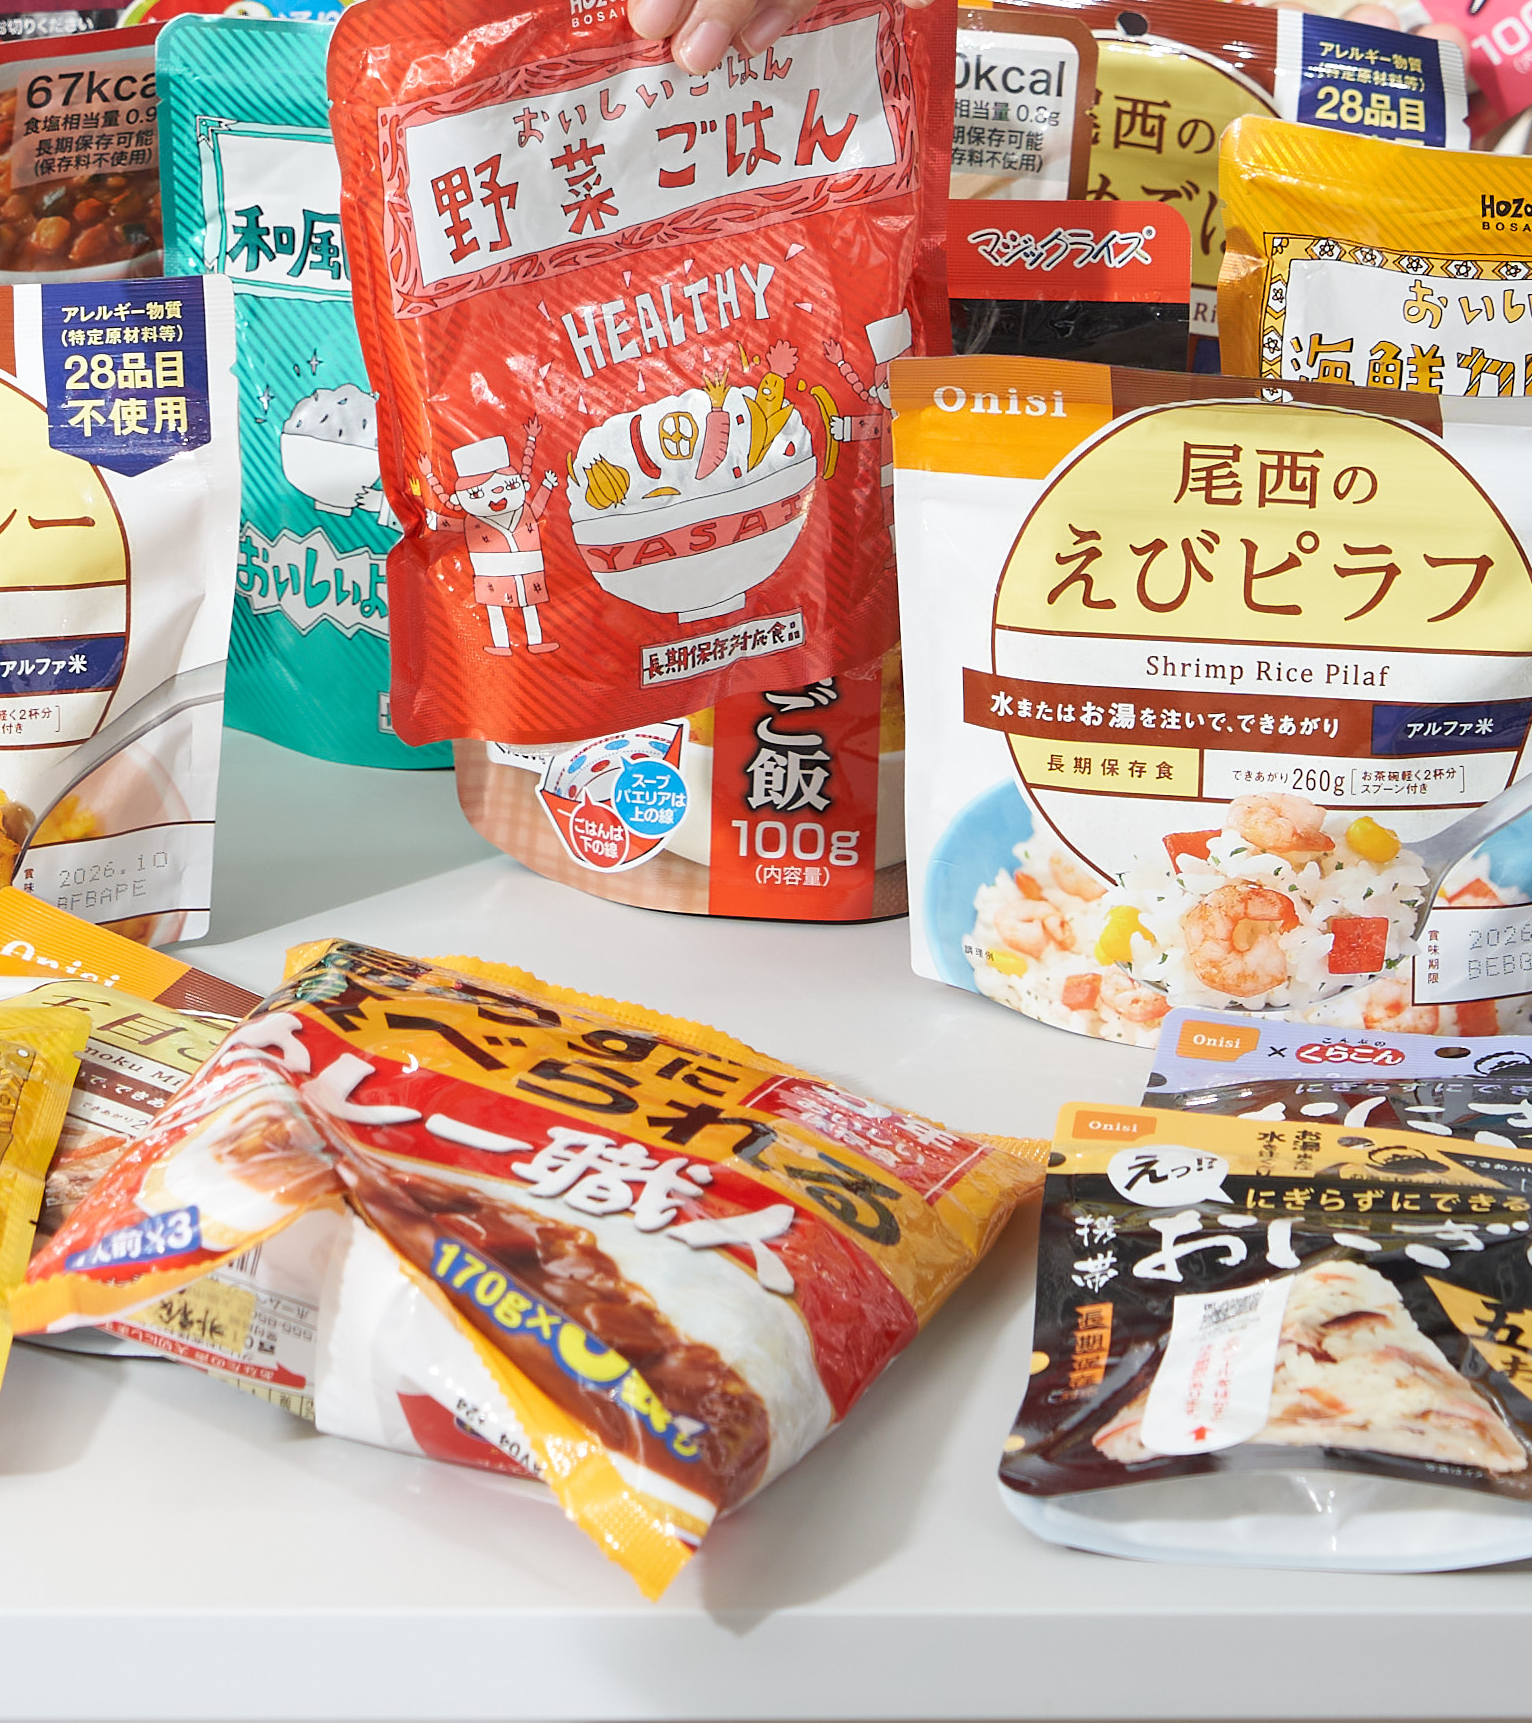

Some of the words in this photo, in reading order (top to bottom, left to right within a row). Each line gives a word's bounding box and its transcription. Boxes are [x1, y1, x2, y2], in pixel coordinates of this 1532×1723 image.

[1318, 40, 1423, 73] アレルギー物質
[22, 111, 122, 137] 食塩相当量
[1016, 103, 1061, 128] 0.8g
[1315, 85, 1427, 132] 28品目
[33, 128, 157, 158] 長期保存可能
[33, 148, 154, 177] (保存料不使用)
[430, 88, 860, 265] 野菜ごはん
[967, 225, 1155, 272] マジックライス
[59, 299, 183, 323] アレルギー物質
[562, 262, 775, 379] HEALTHY
[59, 323, 184, 349] (特定原材料等)
[63, 348, 187, 391] 28品目
[67, 393, 190, 439] 不使用
[933, 383, 1069, 419] Onisi
[1172, 440, 1379, 510] 尾西の
[588, 496, 805, 571] YASAI
[1045, 522, 1497, 625] えびピラフ
[1145, 654, 1245, 688] Shrimp
[1254, 659, 1313, 686] Rice
[1323, 662, 1392, 689] Pilaf
[990, 691, 1341, 739] 水またはお湯を注いで、できあがり
[1405, 716, 1495, 739] アルファ米
[630, 773, 670, 790] スープ
[1045, 753, 1176, 782] 長期保存食
[1231, 767, 1290, 784] できあがり
[1291, 766, 1346, 797] 260g
[1360, 781, 1430, 796] スプーン付き
[615, 788, 687, 807] パエリアは
[573, 817, 624, 841] ごはんは
[628, 805, 675, 824] 上の線
[579, 838, 619, 858] 下の線
[731, 819, 860, 867] 100g
[754, 865, 831, 888] (内容量)
[964, 944, 995, 962] 調理例
[1426, 928, 1441, 986] 賞味期限
[1193, 1032, 1242, 1050] Onisi
[1295, 1041, 1406, 1066] くらこん
[1088, 1119, 1139, 1134] Onisi
[1245, 1185, 1532, 1214] にぎらずにできる
